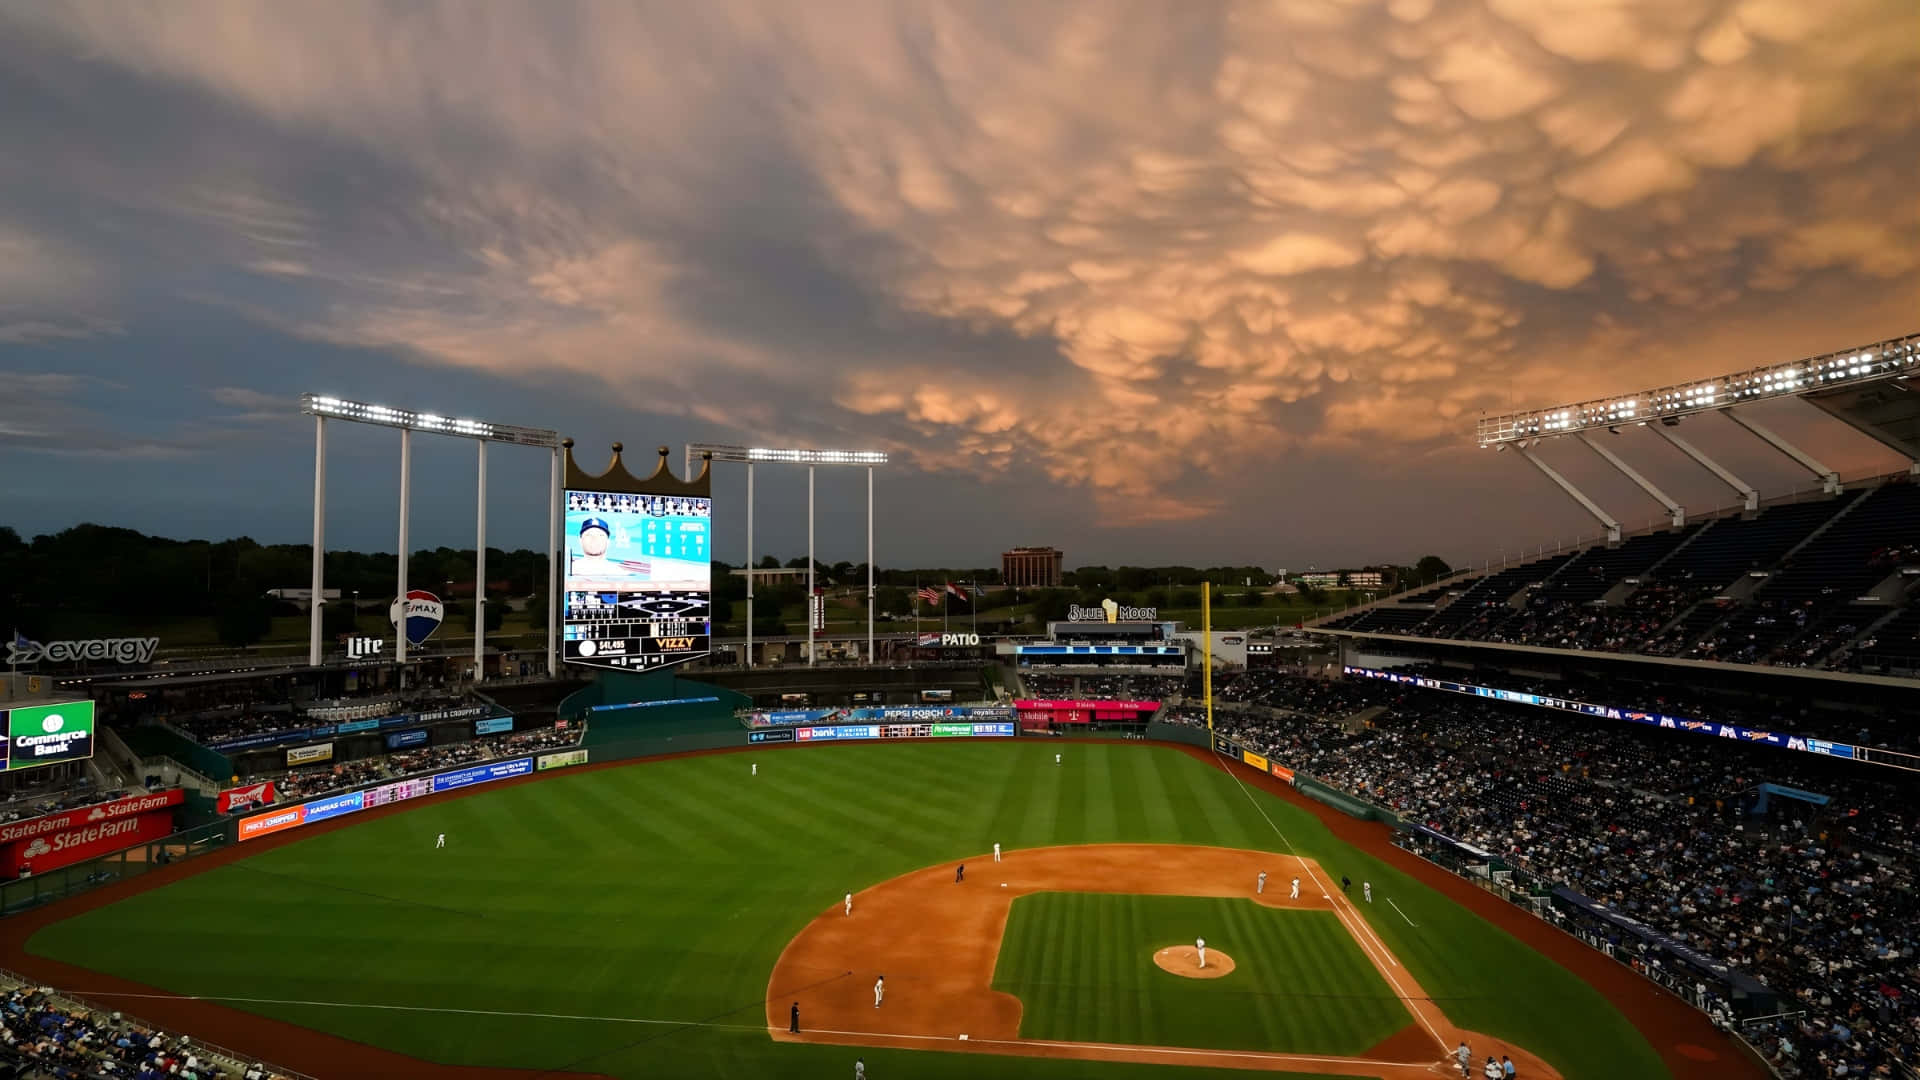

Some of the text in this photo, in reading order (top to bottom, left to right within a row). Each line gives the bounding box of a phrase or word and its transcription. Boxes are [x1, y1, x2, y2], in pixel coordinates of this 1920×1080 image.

[1067, 604, 1157, 622] BLUE MOON
[345, 636, 383, 659] Lite
[655, 638, 696, 648] VIZZY
[942, 633, 979, 646] PATIO
[48, 637, 160, 663] evergy
[885, 708, 943, 717] PEPSI PORCH
[973, 709, 1010, 717] royals.com
[16, 730, 87, 747] Commerce
[812, 728, 835, 737] bank
[34, 742, 69, 756] Bank
[107, 795, 168, 817] State Farm
[232, 793, 261, 806] SONIC
[310, 798, 355, 815] KANSAS CITY
[1, 817, 70, 841] State Farm
[53, 817, 137, 851] State Farm
